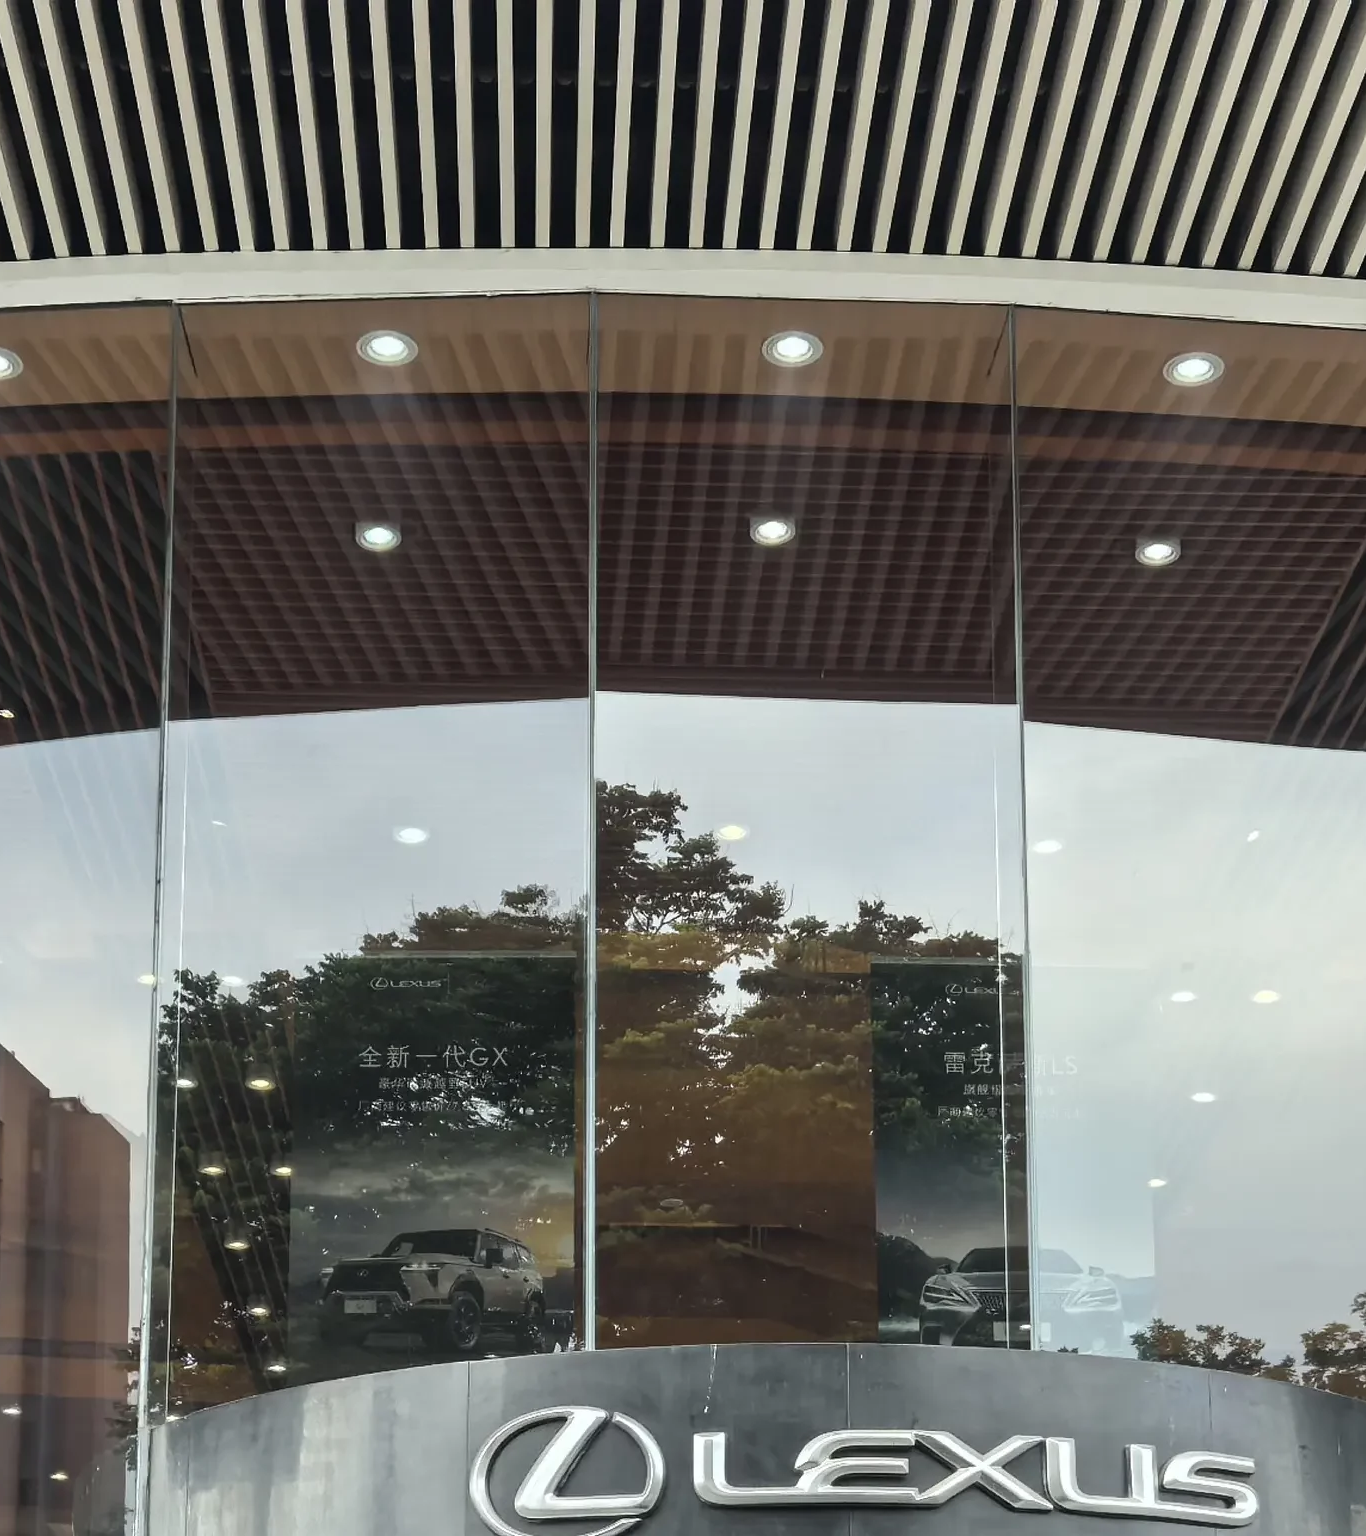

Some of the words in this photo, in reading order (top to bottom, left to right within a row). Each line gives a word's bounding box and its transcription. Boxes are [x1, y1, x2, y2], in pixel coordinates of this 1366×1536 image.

[390, 978, 442, 989] LEXUS
[358, 1044, 509, 1069] 全新一代GX
[692, 1428, 1261, 1529] LEXUS
